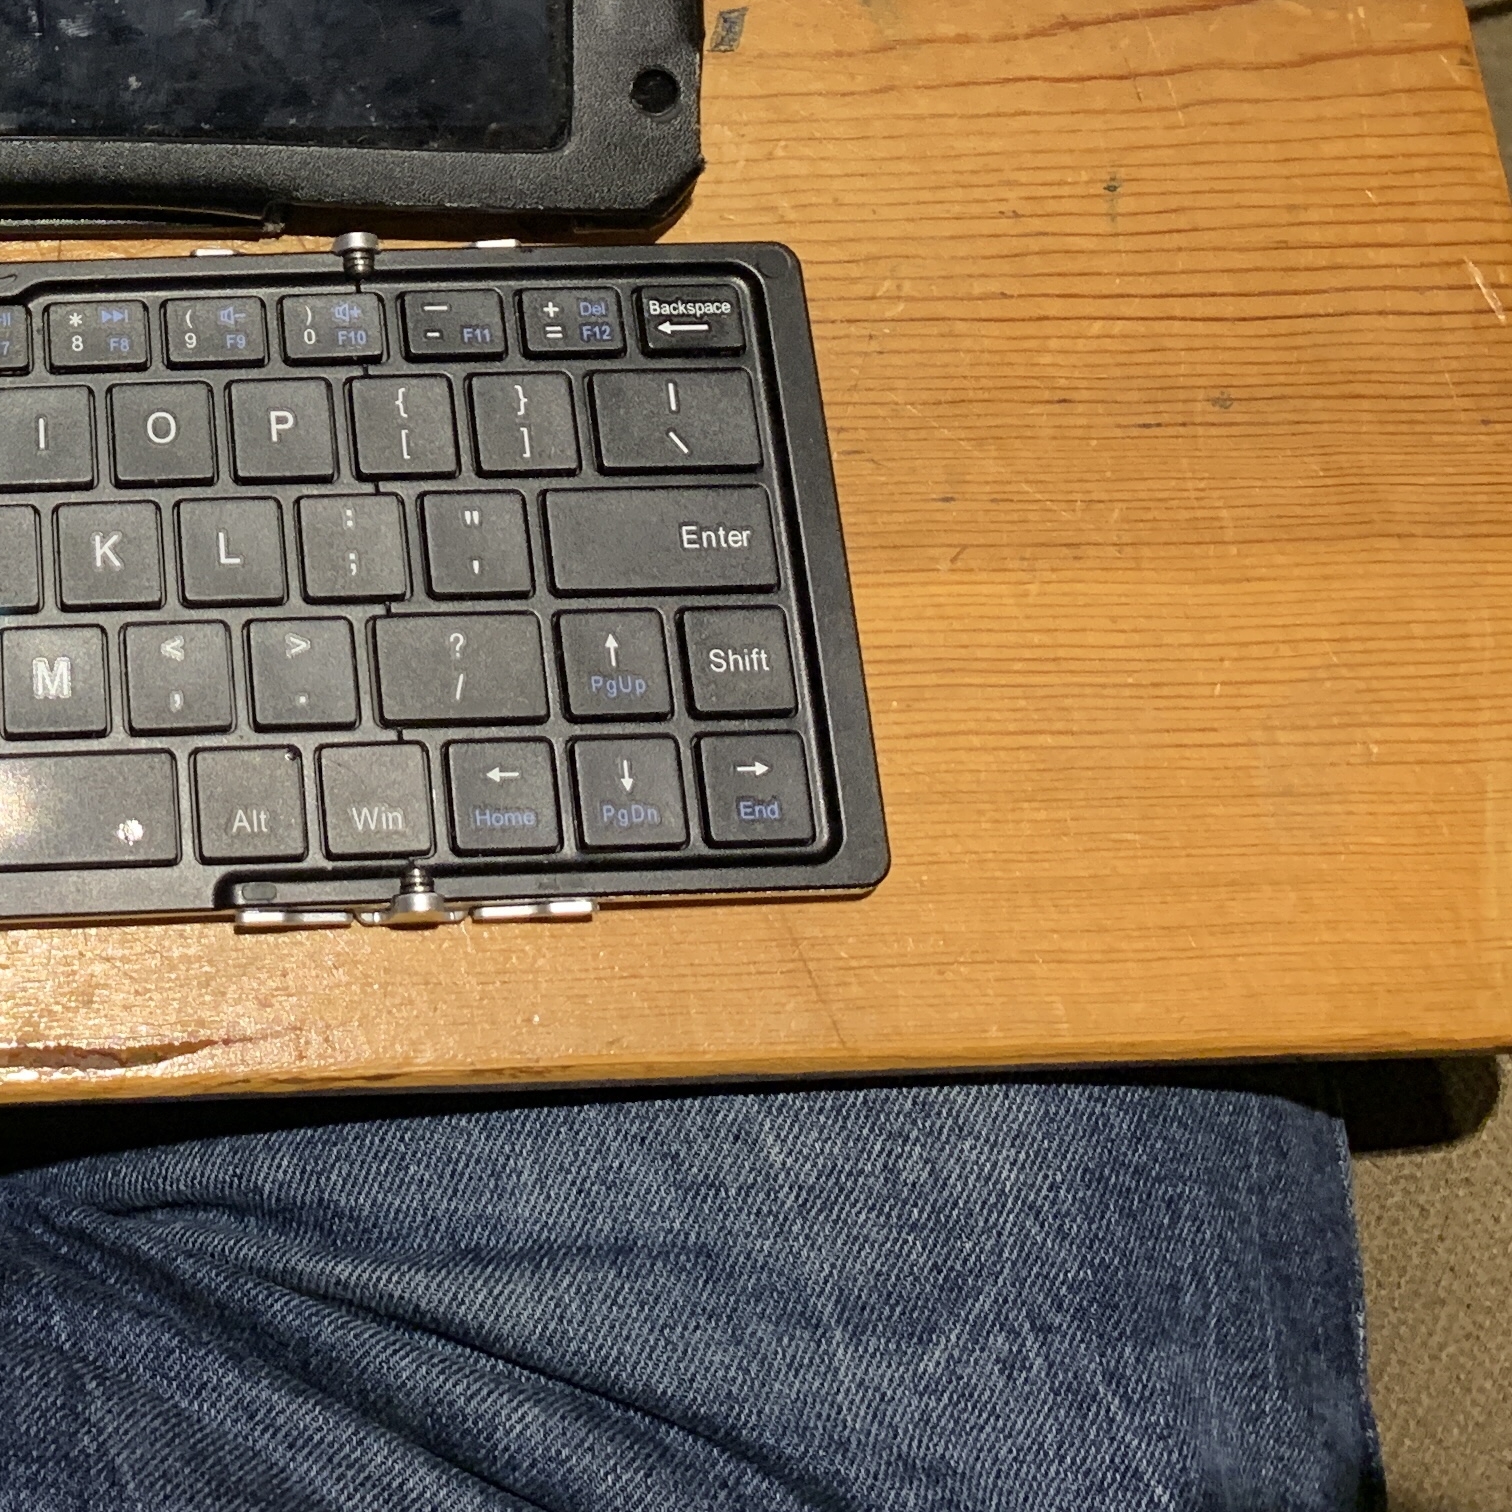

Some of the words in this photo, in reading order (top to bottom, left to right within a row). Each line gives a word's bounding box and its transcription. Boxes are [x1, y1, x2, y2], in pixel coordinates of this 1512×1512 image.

[543, 302, 559, 317] +
[580, 303, 605, 316] Del
[649, 301, 731, 316] Backspace
[185, 333, 196, 349] 9
[226, 335, 246, 348] F9
[304, 329, 316, 345] 0
[339, 331, 366, 345] F10
[463, 329, 490, 342] F11
[582, 326, 610, 339] F12
[72, 336, 83, 351] 8
[110, 339, 129, 352] F8
[396, 388, 407, 417] {
[515, 385, 527, 415] }
[39, 418, 45, 450] I
[147, 412, 176, 444] O
[270, 411, 293, 441] P
[401, 430, 410, 459] [
[520, 428, 530, 457] ]
[681, 527, 750, 548] Enter
[94, 535, 121, 568] K
[218, 533, 241, 564] L
[450, 633, 464, 658] ?
[710, 650, 769, 672] Shift
[34, 658, 71, 698] M
[591, 676, 646, 697] PgUp
[233, 810, 268, 832] Alt
[352, 807, 403, 830] Win
[475, 810, 536, 826] Home
[603, 805, 658, 826] PgDn
[739, 802, 779, 819] End
